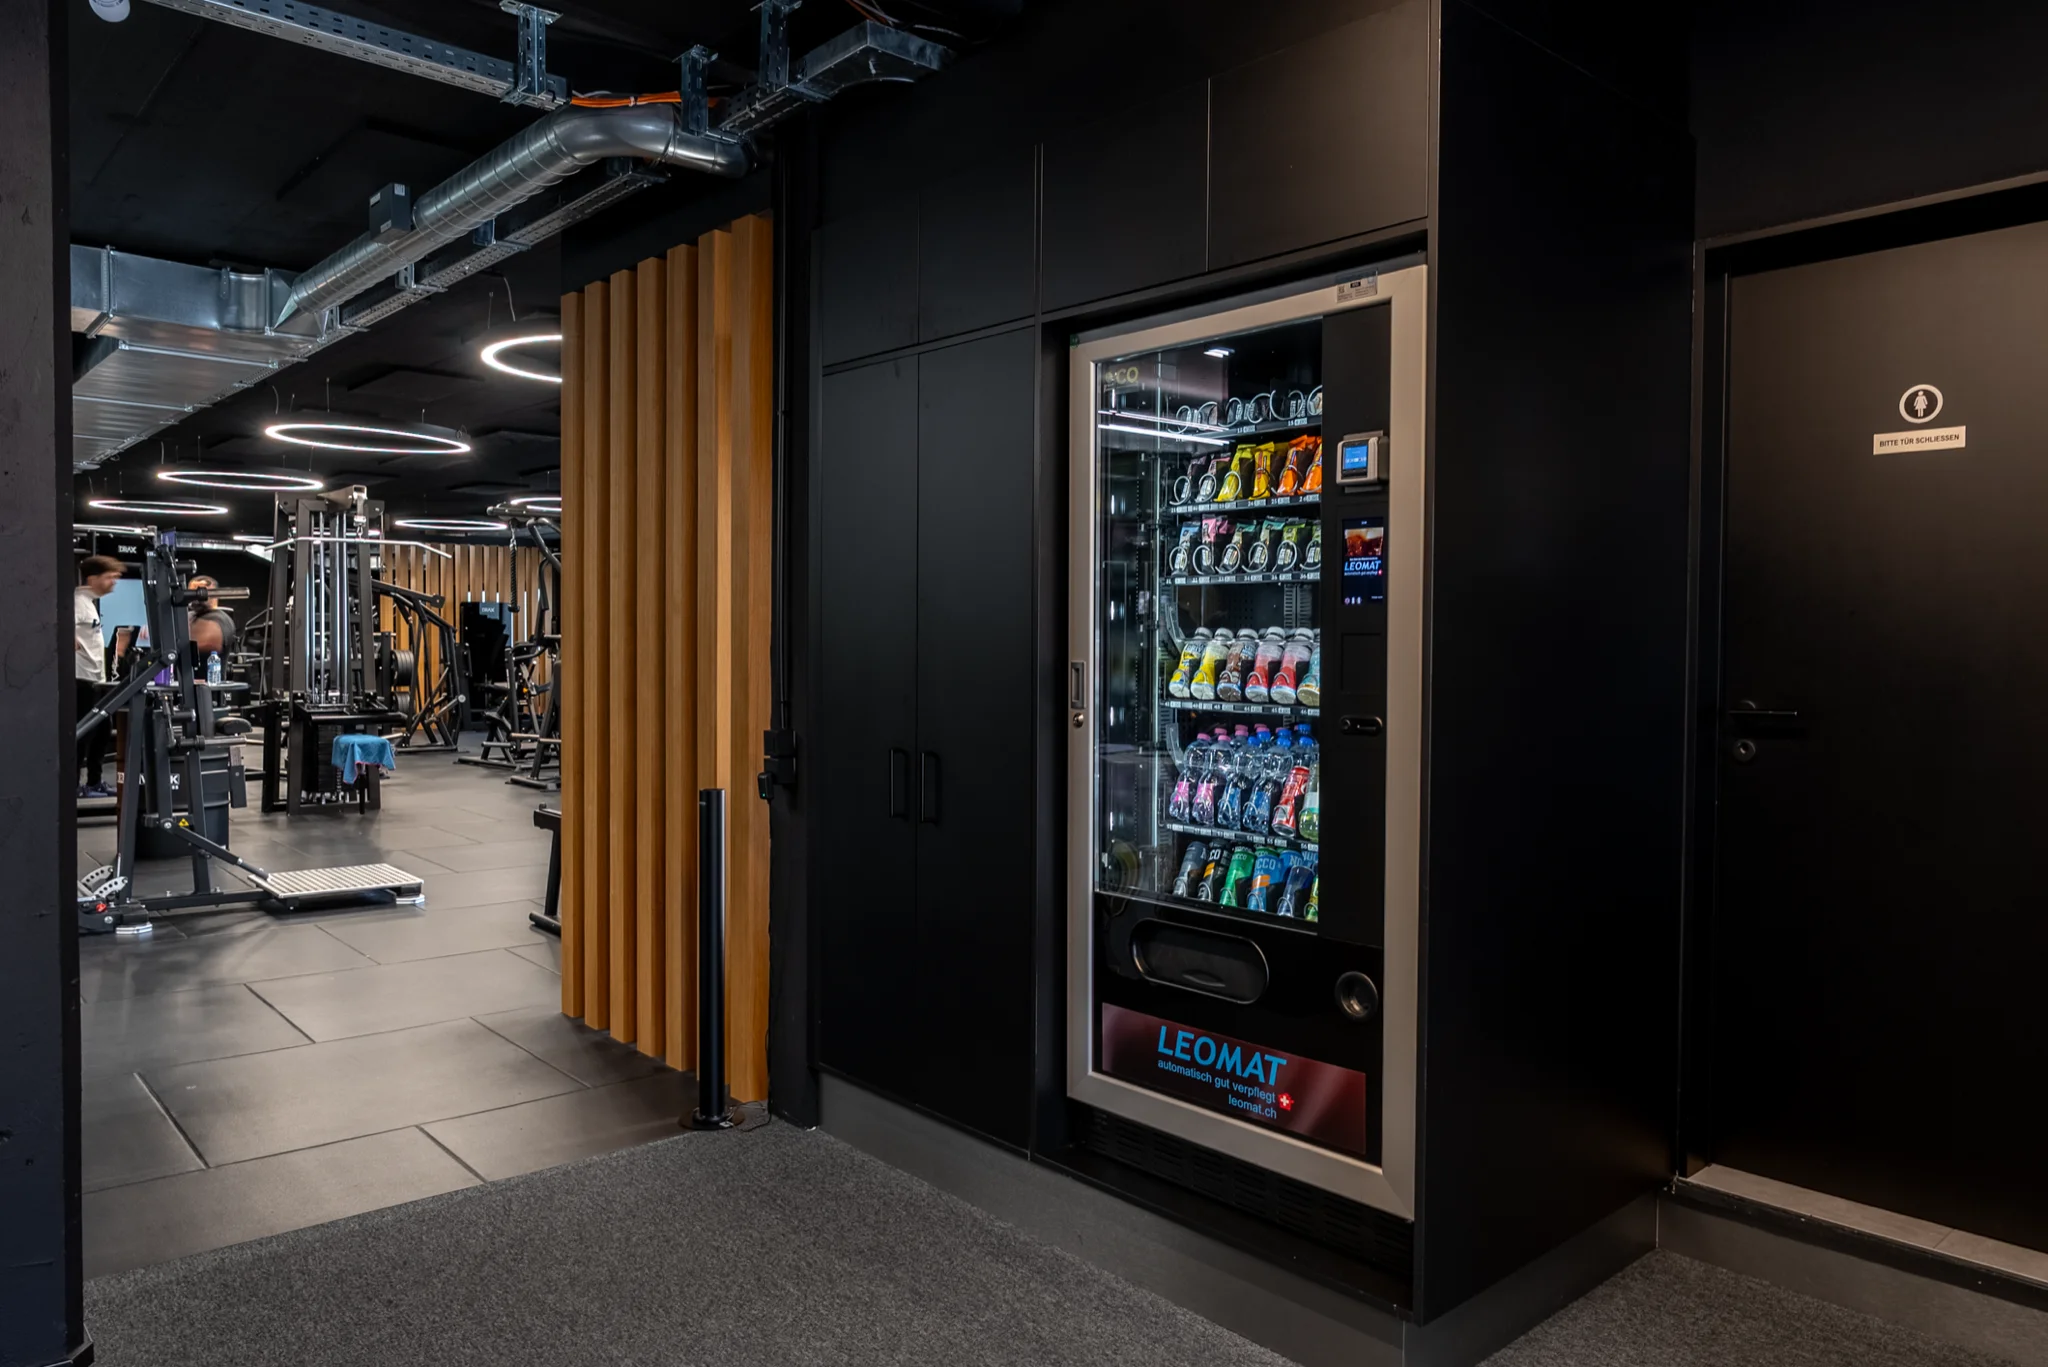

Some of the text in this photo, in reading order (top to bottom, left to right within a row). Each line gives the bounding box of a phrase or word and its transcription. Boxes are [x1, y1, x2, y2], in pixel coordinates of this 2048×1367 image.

[1879, 433, 1960, 448] BITTE TÜR SCHLIESSEN
[1344, 560, 1382, 571] LEOMAT
[1157, 1025, 1287, 1086] LEOMAT
[1157, 1057, 1276, 1104] automatisch gut verpflegt
[1228, 1093, 1277, 1120] leomat.ch
